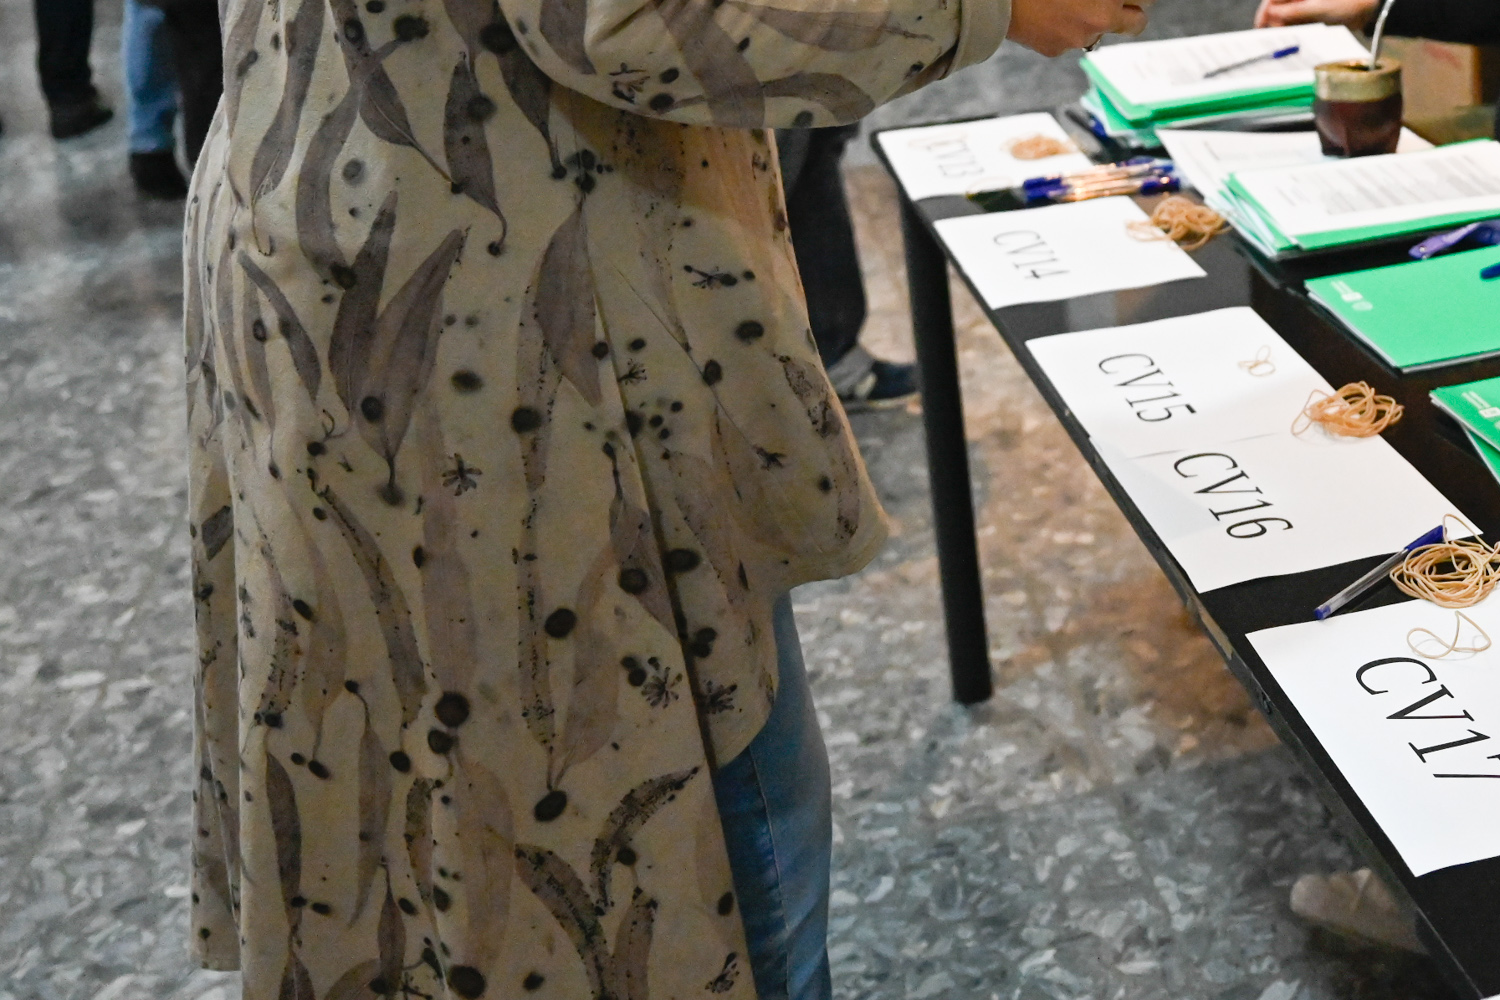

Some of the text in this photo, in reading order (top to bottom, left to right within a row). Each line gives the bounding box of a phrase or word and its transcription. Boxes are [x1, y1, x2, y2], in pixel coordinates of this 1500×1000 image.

[992, 229, 1070, 279] CV14
[1098, 353, 1197, 422] CV15
[1174, 452, 1294, 538] CV16
